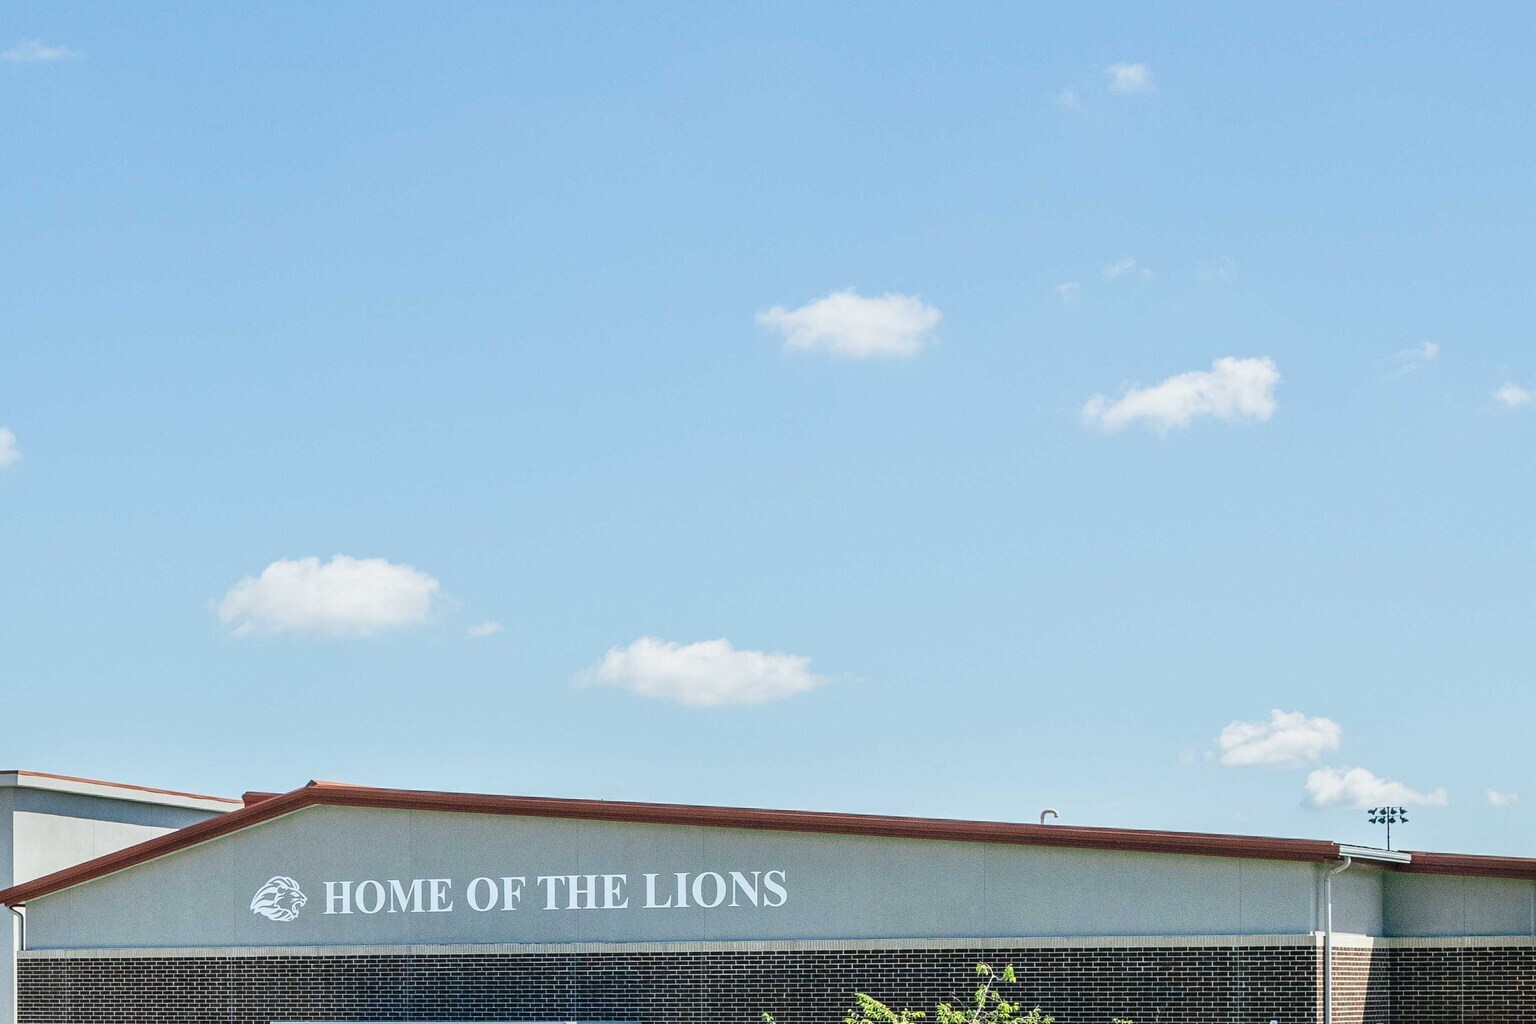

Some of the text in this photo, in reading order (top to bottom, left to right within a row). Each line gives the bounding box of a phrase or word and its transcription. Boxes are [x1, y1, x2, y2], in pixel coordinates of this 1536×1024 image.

[322, 870, 787, 914] HOME OF THE LIONS
